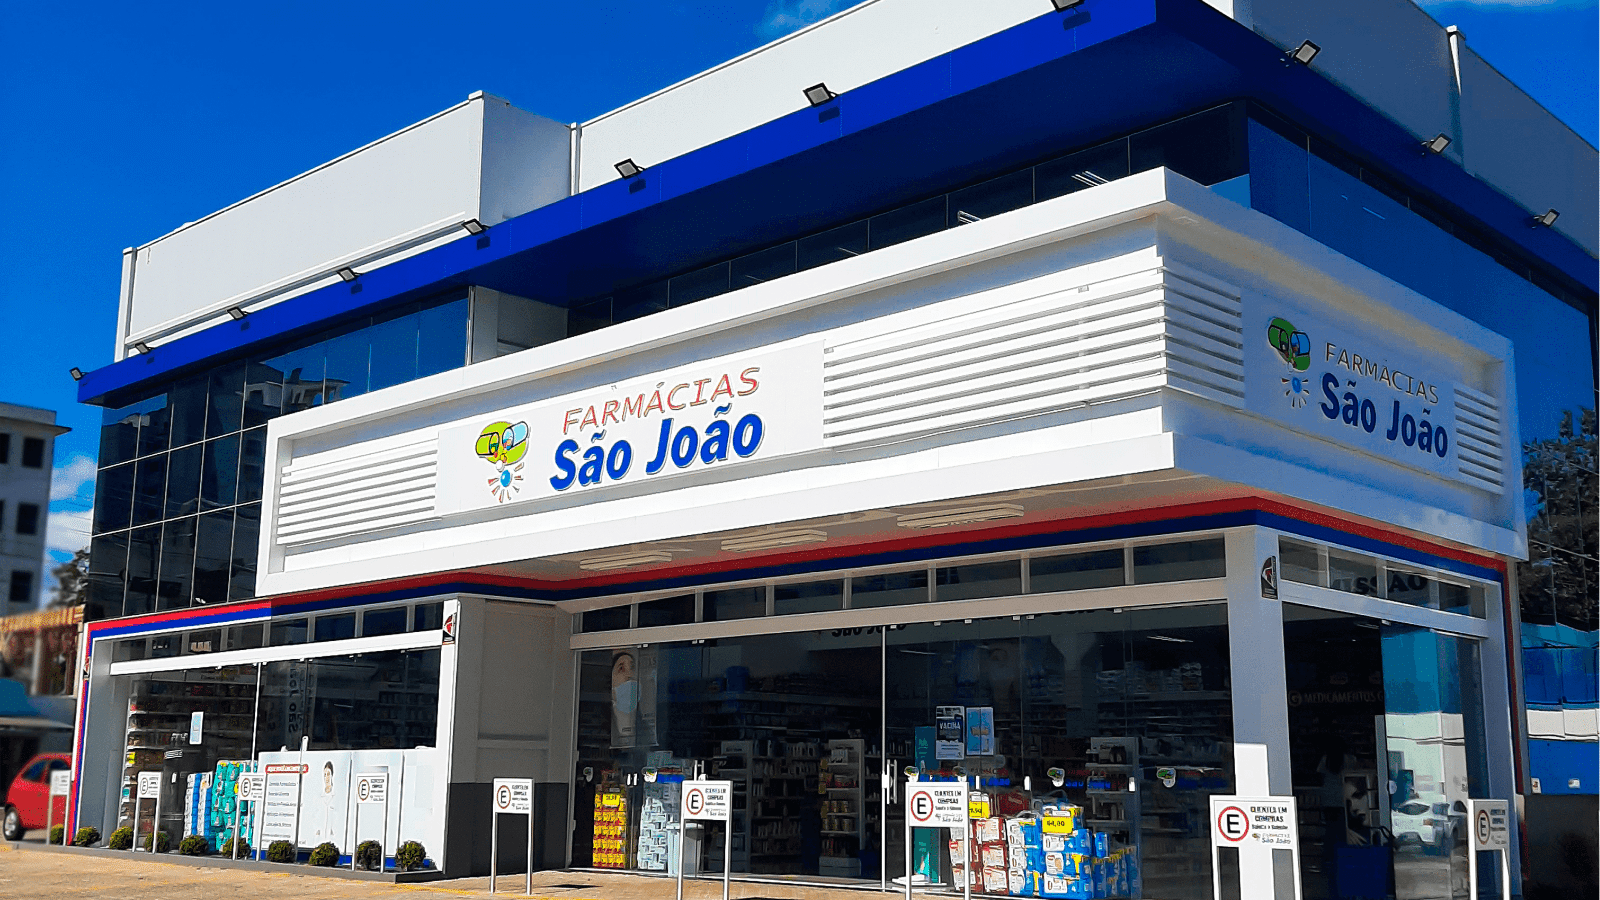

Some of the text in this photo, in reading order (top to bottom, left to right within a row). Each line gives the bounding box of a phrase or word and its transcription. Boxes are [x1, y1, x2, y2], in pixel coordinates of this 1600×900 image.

[1325, 343, 1439, 404] FARMÁCIAS
[563, 367, 760, 434] FARMÁCIAS
[1321, 373, 1448, 457] São João
[550, 402, 765, 492] São João
[501, 790, 507, 803] E
[691, 795, 699, 809] E
[917, 798, 927, 814] E
[1227, 814, 1240, 833] E
